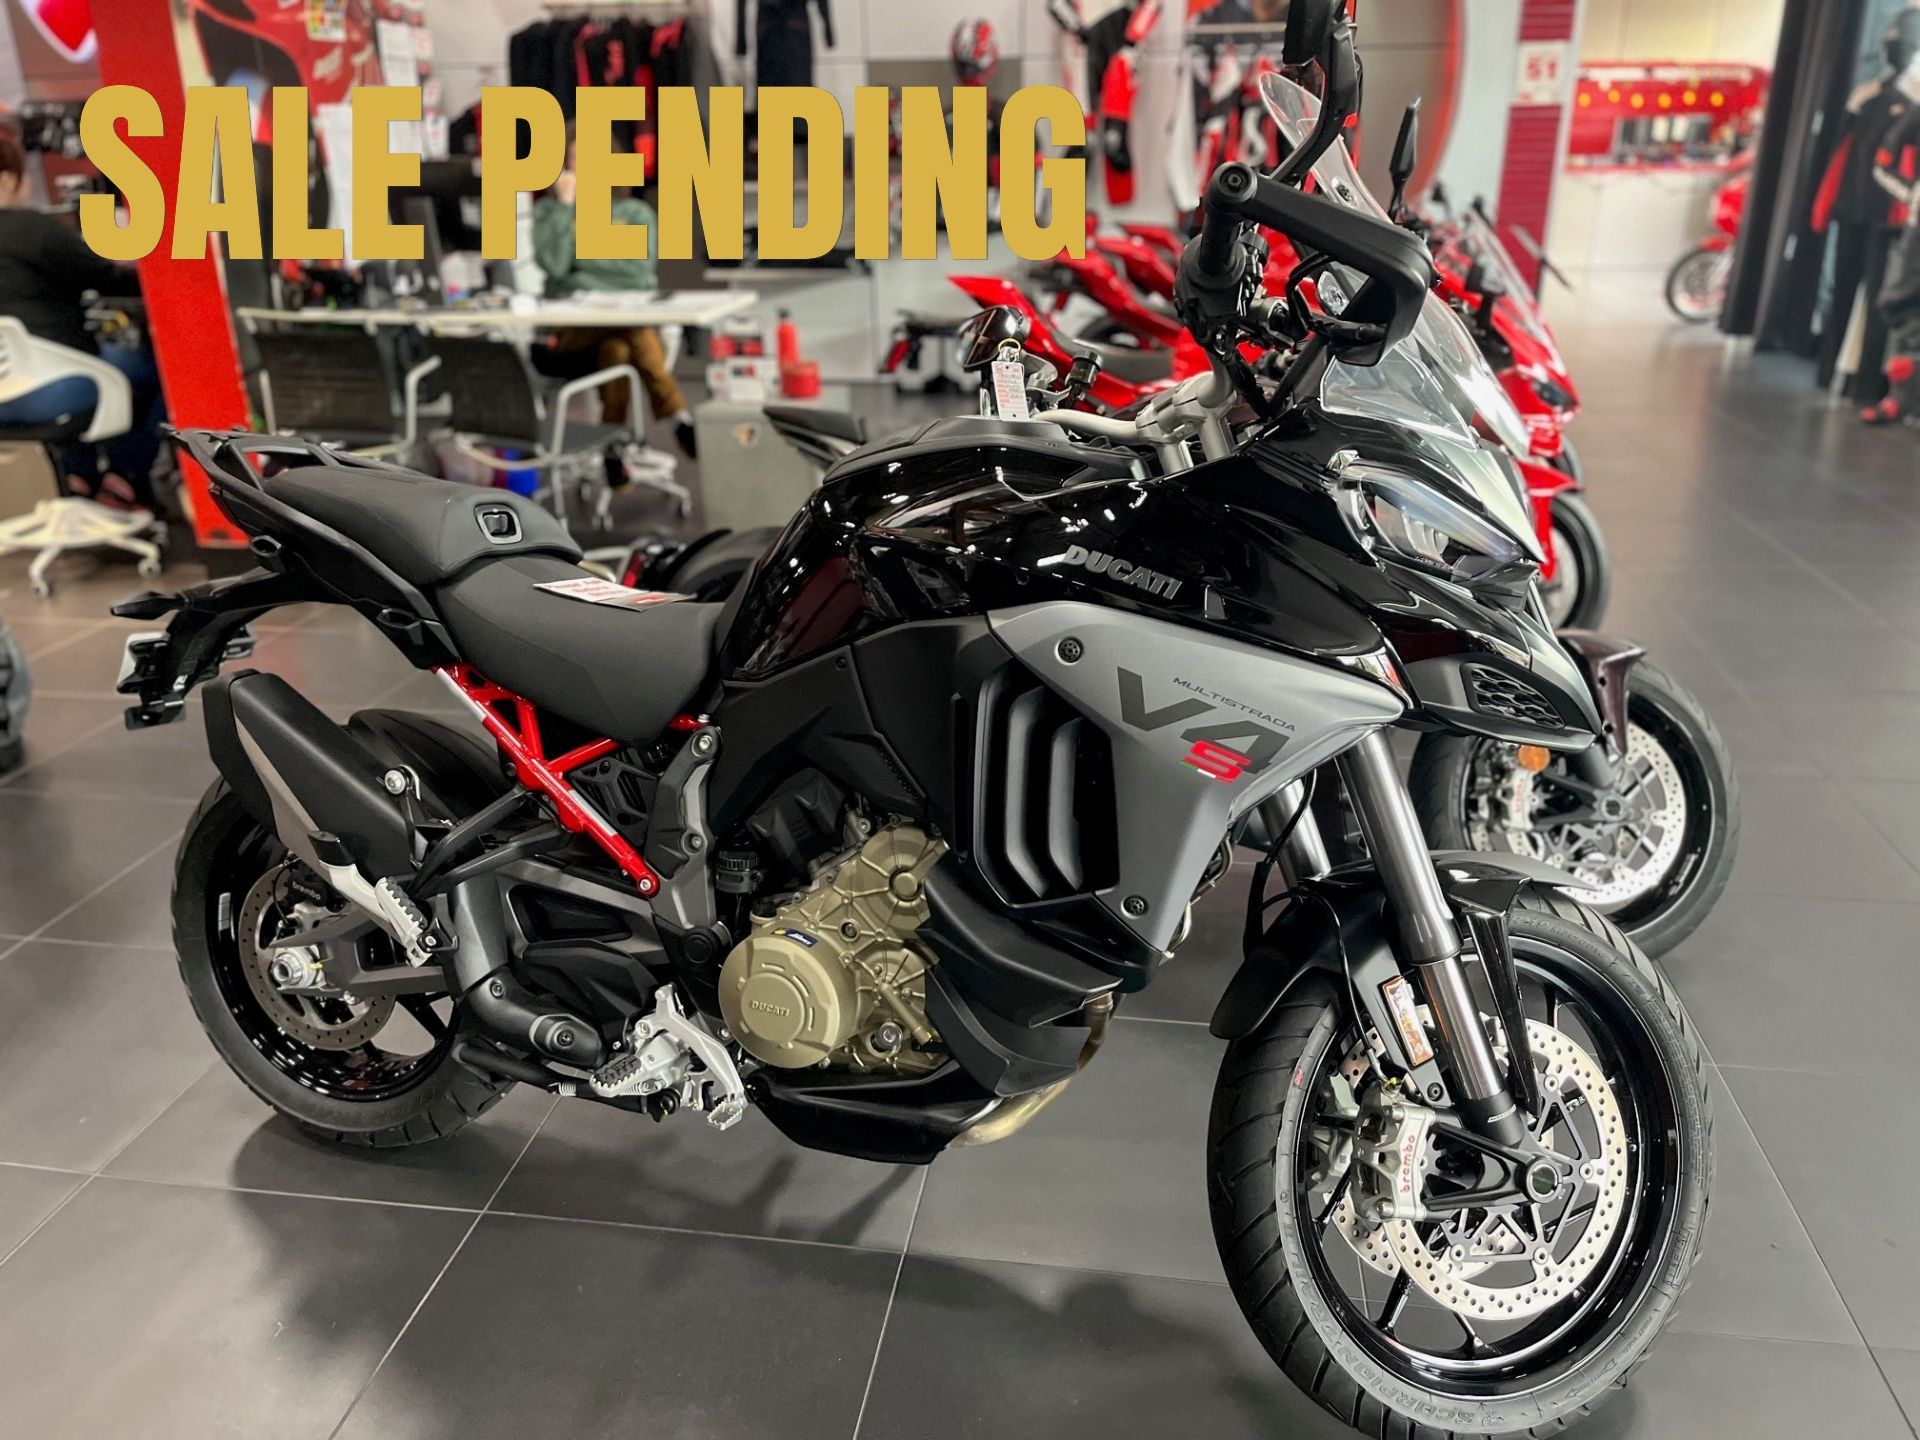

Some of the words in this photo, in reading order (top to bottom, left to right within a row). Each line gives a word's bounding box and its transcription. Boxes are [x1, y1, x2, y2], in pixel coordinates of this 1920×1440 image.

[1062, 544, 1182, 600] DUCATI
[1172, 676, 1296, 732] MULTISTRADA
[292, 880, 321, 900] brembo
[750, 1000, 791, 1017] DUCATI
[1400, 1134, 1415, 1193] brembo
[1333, 1342, 1475, 1426] SCORPION
